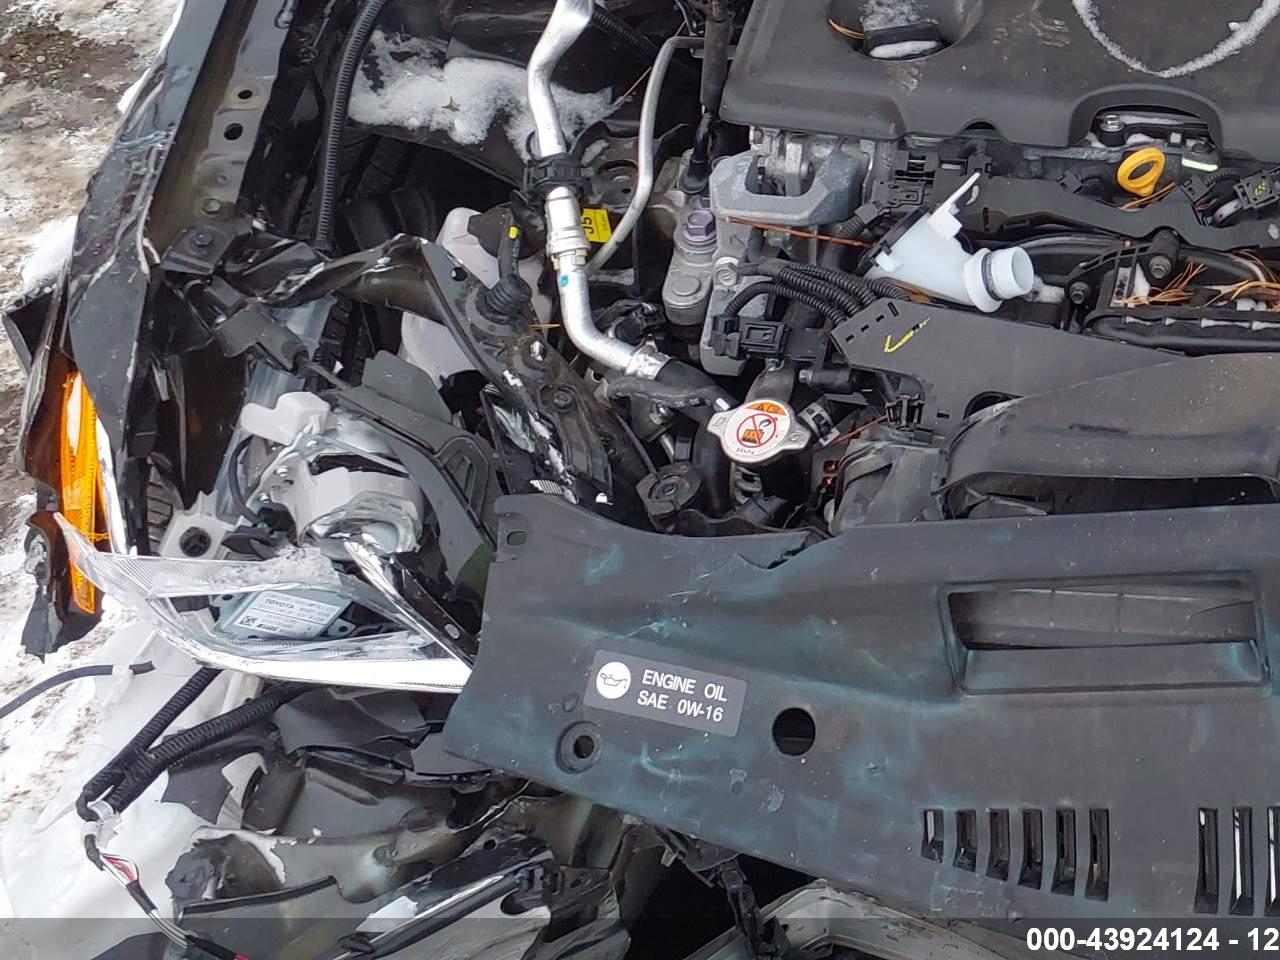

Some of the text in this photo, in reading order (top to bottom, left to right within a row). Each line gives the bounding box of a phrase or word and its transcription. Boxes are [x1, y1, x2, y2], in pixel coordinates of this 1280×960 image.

[264, 598, 295, 609] TOYOTA
[642, 669, 728, 702] ENGINE OIL
[637, 690, 723, 722] SAE 0W-16
